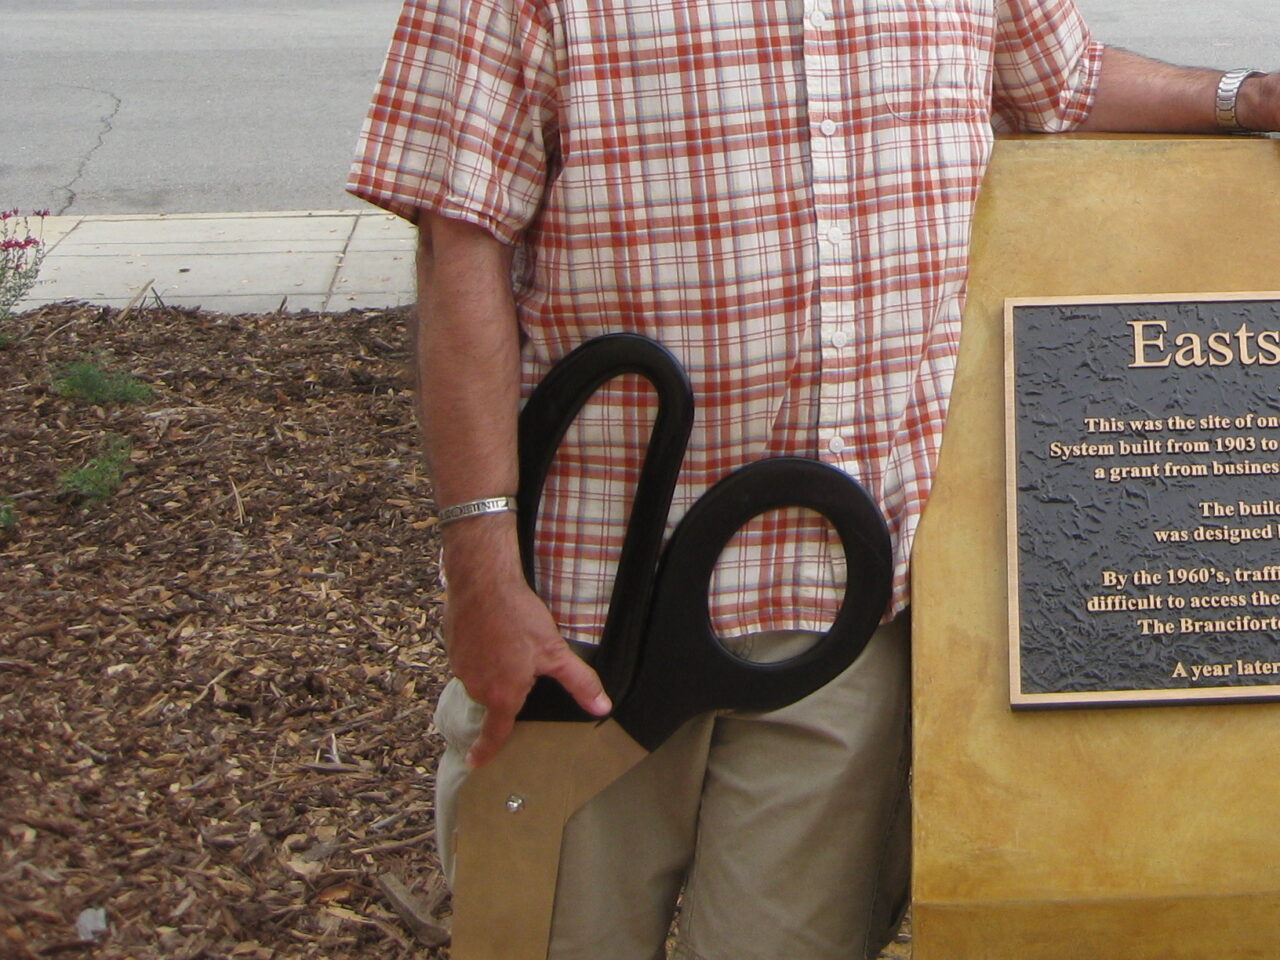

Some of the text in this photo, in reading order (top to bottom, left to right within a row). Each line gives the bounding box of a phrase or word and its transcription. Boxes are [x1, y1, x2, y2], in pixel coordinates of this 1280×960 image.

[1084, 417, 1124, 432] This
[1128, 419, 1163, 430] was
[1166, 415, 1195, 429] the
[1199, 414, 1230, 429] site
[1234, 412, 1254, 428] of
[1050, 441, 1114, 460] System
[1118, 439, 1161, 455] built
[1166, 438, 1210, 452] from
[1215, 436, 1256, 451] 1903
[1260, 437, 1278, 450] to
[1094, 467, 1105, 478] a
[1109, 463, 1159, 481] grant
[1163, 462, 1208, 476] from
[1198, 501, 1234, 516] The
[1153, 529, 1188, 542] was
[1193, 523, 1272, 543] designed
[1102, 570, 1128, 589] By
[1133, 569, 1161, 585] the
[1086, 594, 1162, 611] difficult
[1166, 594, 1185, 609] to
[1190, 594, 1246, 607] access
[1250, 591, 1280, 605] the
[1136, 618, 1175, 634] The
[1171, 661, 1187, 678] A
[1190, 663, 1233, 681] year
[1236, 659, 1280, 675] later
